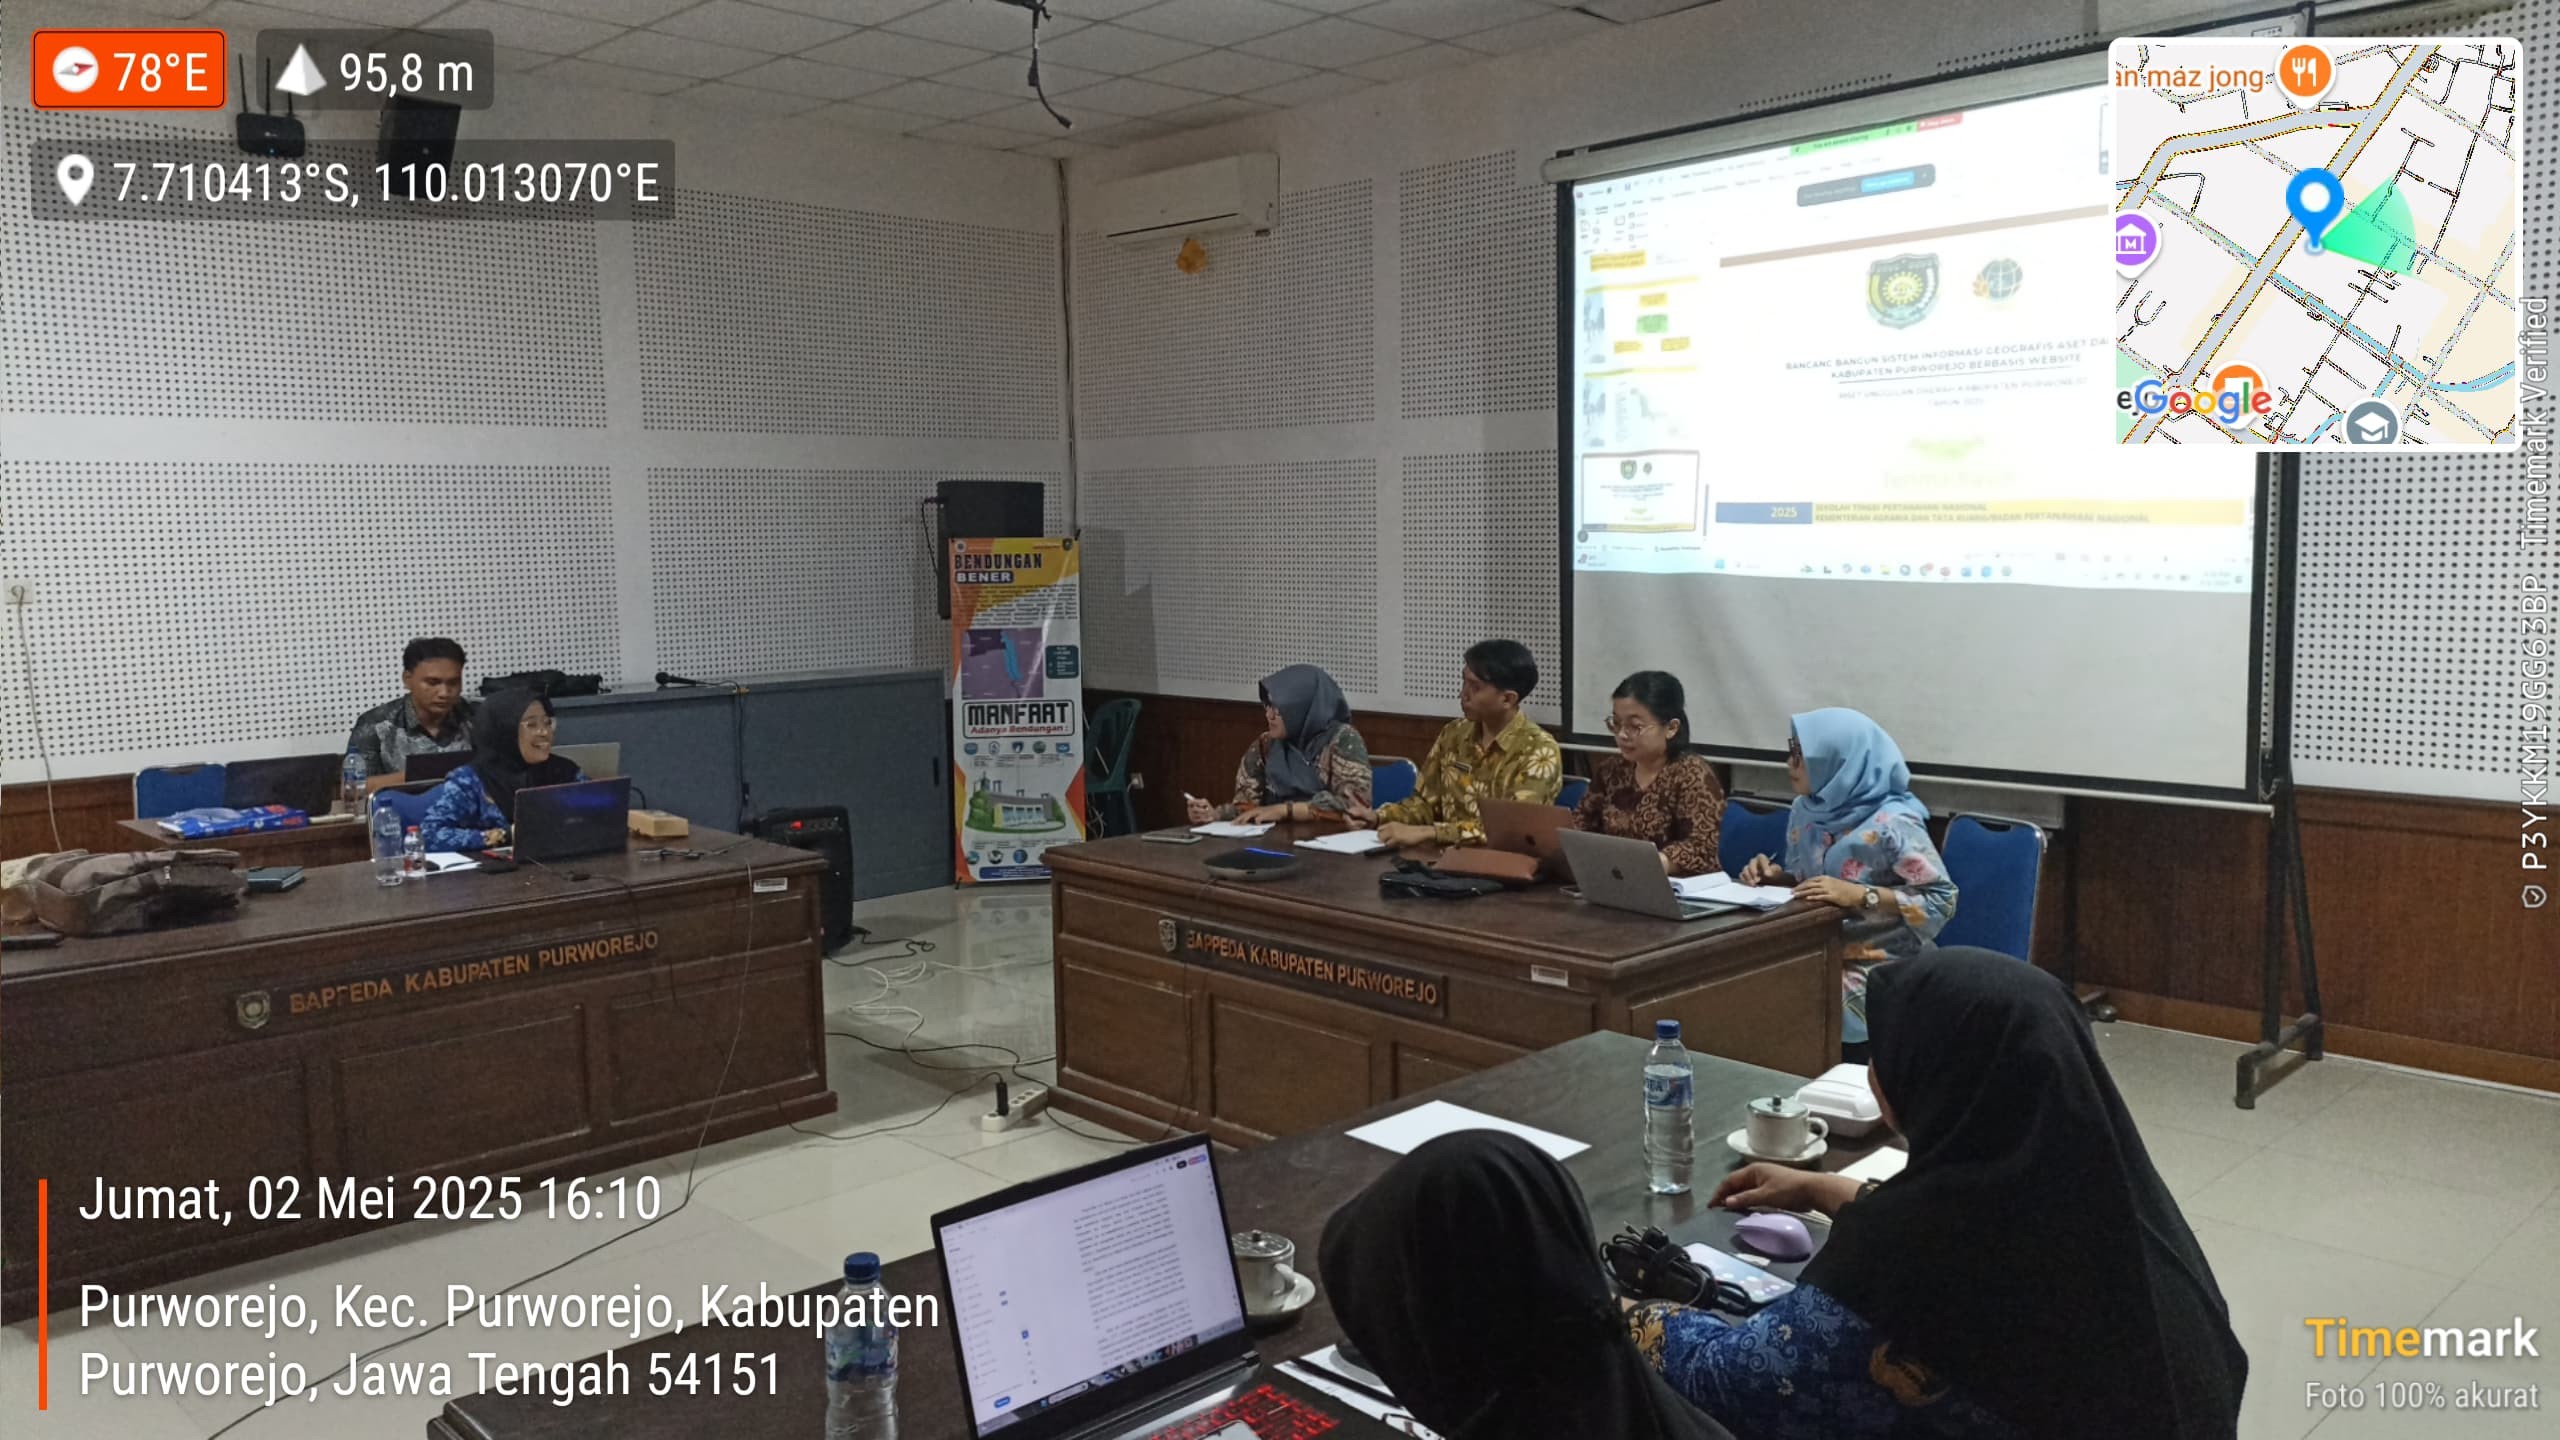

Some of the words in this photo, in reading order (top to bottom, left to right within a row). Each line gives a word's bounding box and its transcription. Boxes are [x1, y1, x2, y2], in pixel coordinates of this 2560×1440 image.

[1881, 352, 1919, 363] SISTEM
[1921, 347, 1983, 360] INFORMASI
[1831, 366, 1893, 379] KABUPATEN
[1895, 362, 1966, 375] PURWOREJO
[1969, 358, 2025, 370] BERBASIS
[2028, 352, 2081, 365] WEBSITE
[1770, 505, 1798, 518] 2025
[954, 553, 1042, 569] BENDUNGAN
[956, 571, 1012, 583] BENER
[968, 702, 1069, 726] MANFAAT
[970, 726, 1008, 735] Adanya
[1009, 725, 1063, 734] Bendungan
[289, 977, 393, 1015] BAPEDA
[404, 953, 531, 994] KABUPATEN
[538, 931, 659, 969] PURWOREJO
[1250, 943, 1335, 984] KABUPATEN
[1337, 964, 1437, 1005] PURWOREJO
